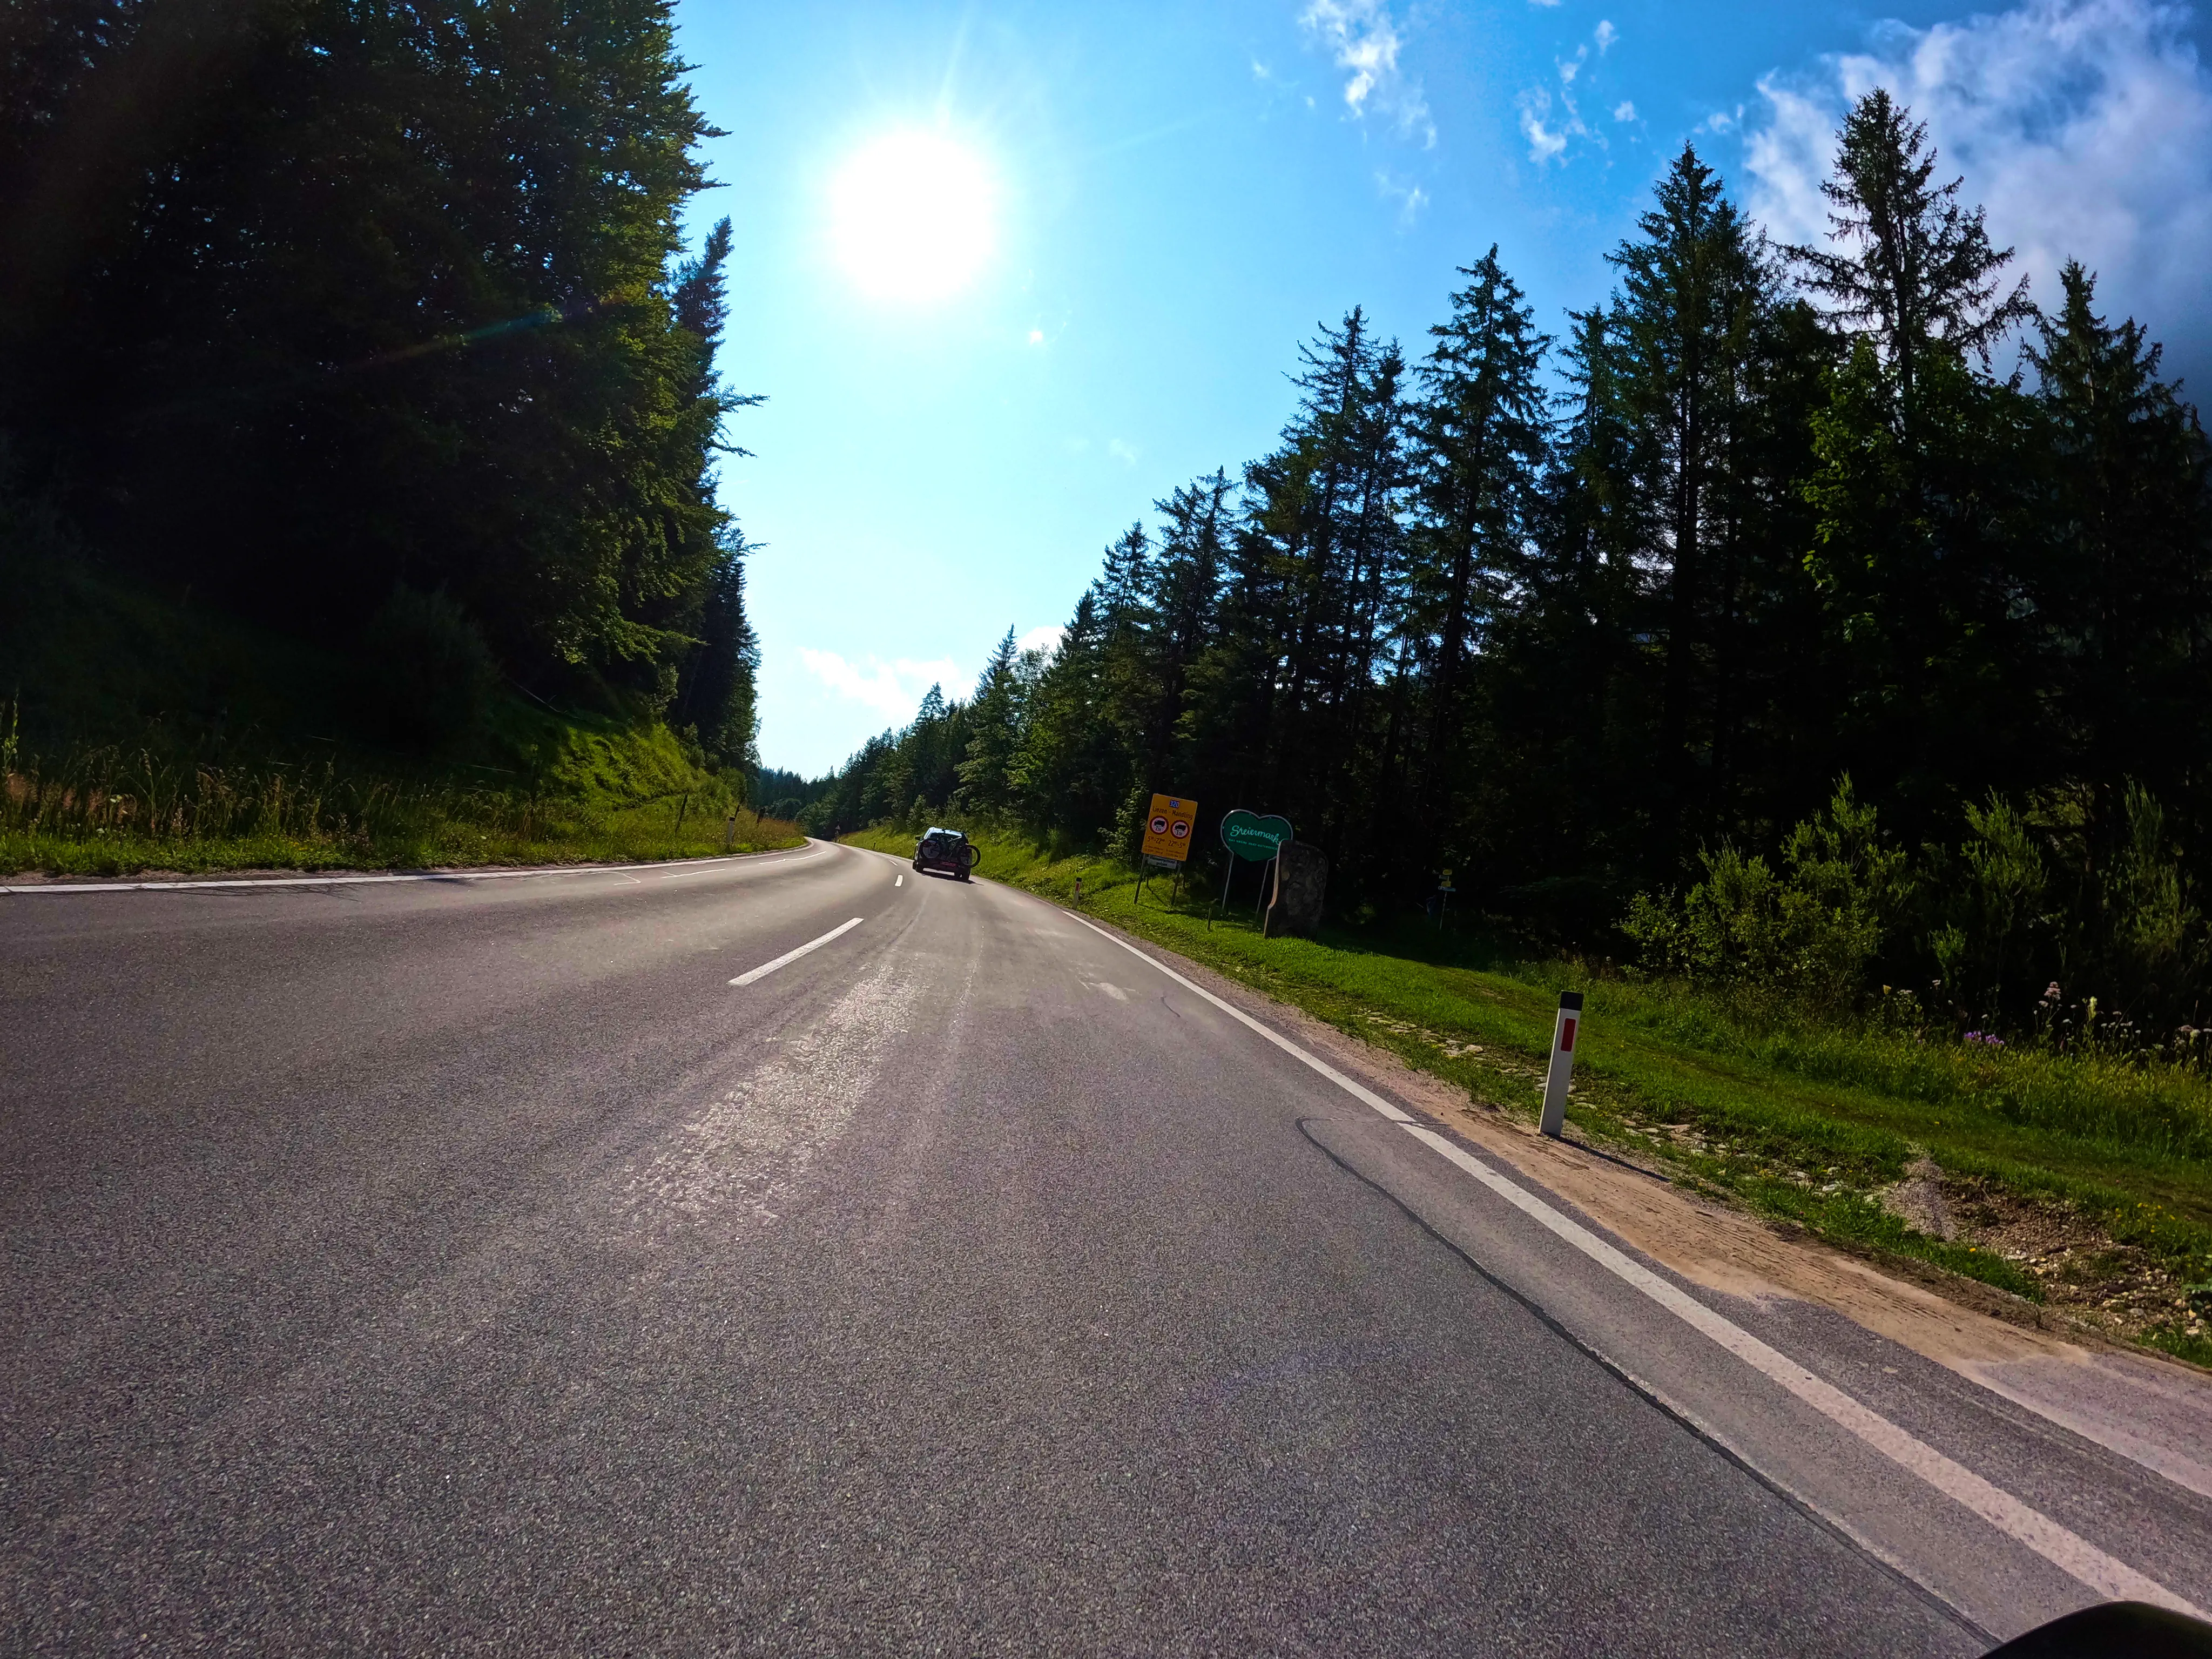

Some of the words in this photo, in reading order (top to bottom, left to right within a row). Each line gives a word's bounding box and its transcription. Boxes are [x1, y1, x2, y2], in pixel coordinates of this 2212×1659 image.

[1152, 806, 1167, 814] Liezen
[1172, 810, 1193, 820] Mandling
[1230, 825, 1280, 845] Steiermark
